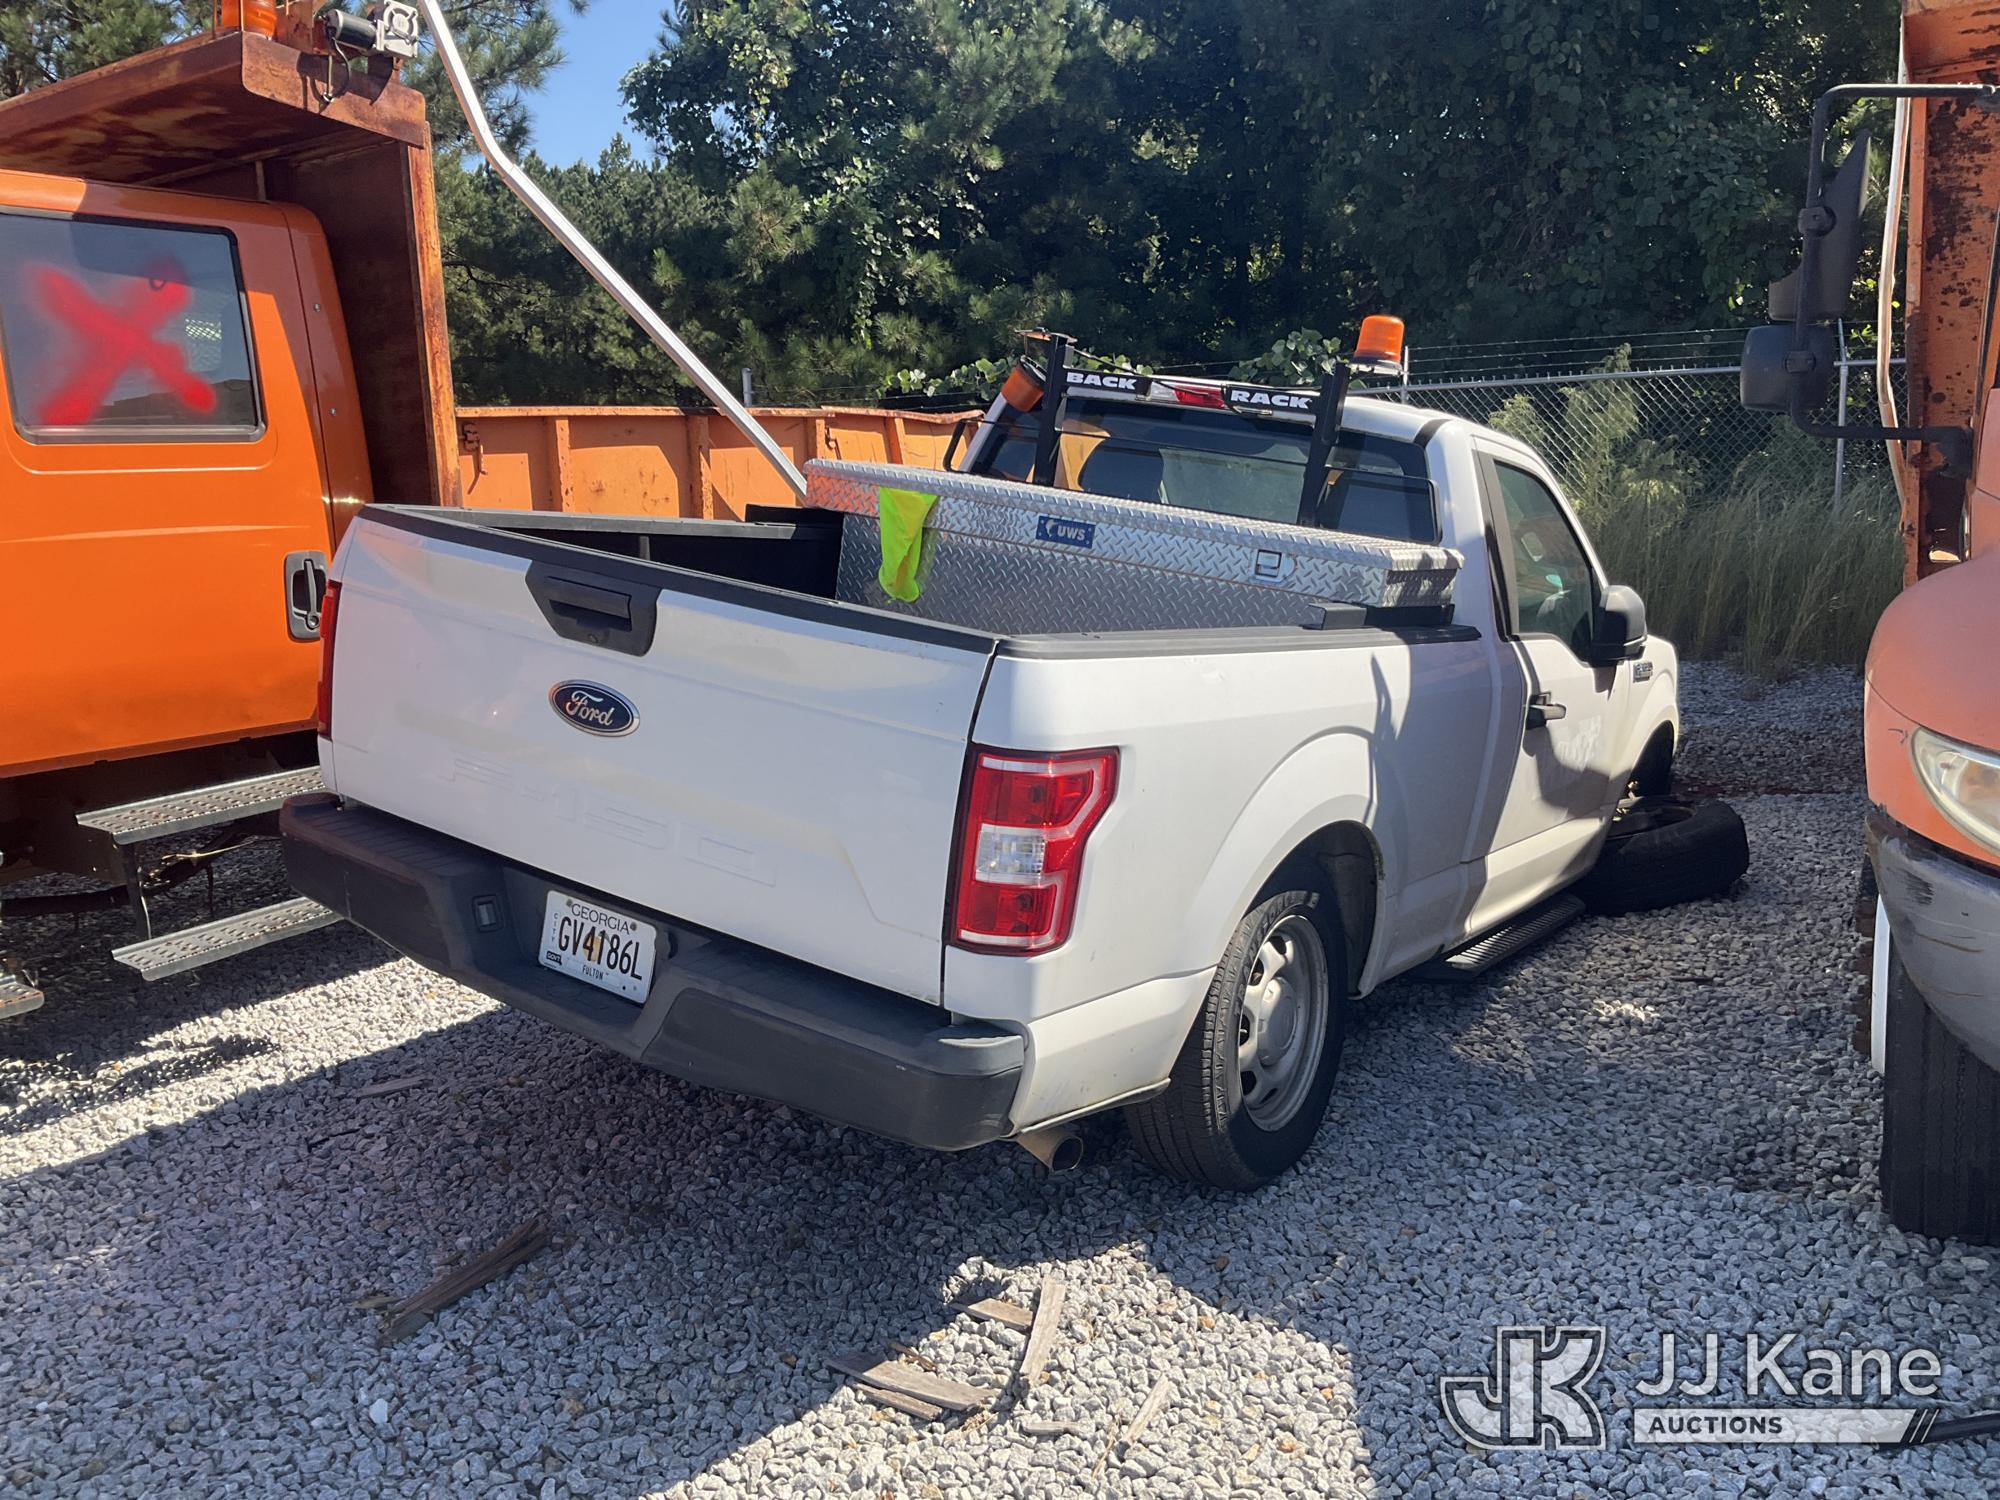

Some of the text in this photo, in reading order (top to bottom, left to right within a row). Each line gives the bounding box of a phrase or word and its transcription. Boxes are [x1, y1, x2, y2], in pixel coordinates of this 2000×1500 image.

[1066, 371, 1310, 410] BACK RACK
[1057, 524, 1086, 541] UWS
[565, 690, 616, 726] Ford
[571, 903, 630, 935] GEORGIA
[558, 916, 643, 981] GV4186L
[582, 964, 604, 981] FULTON
